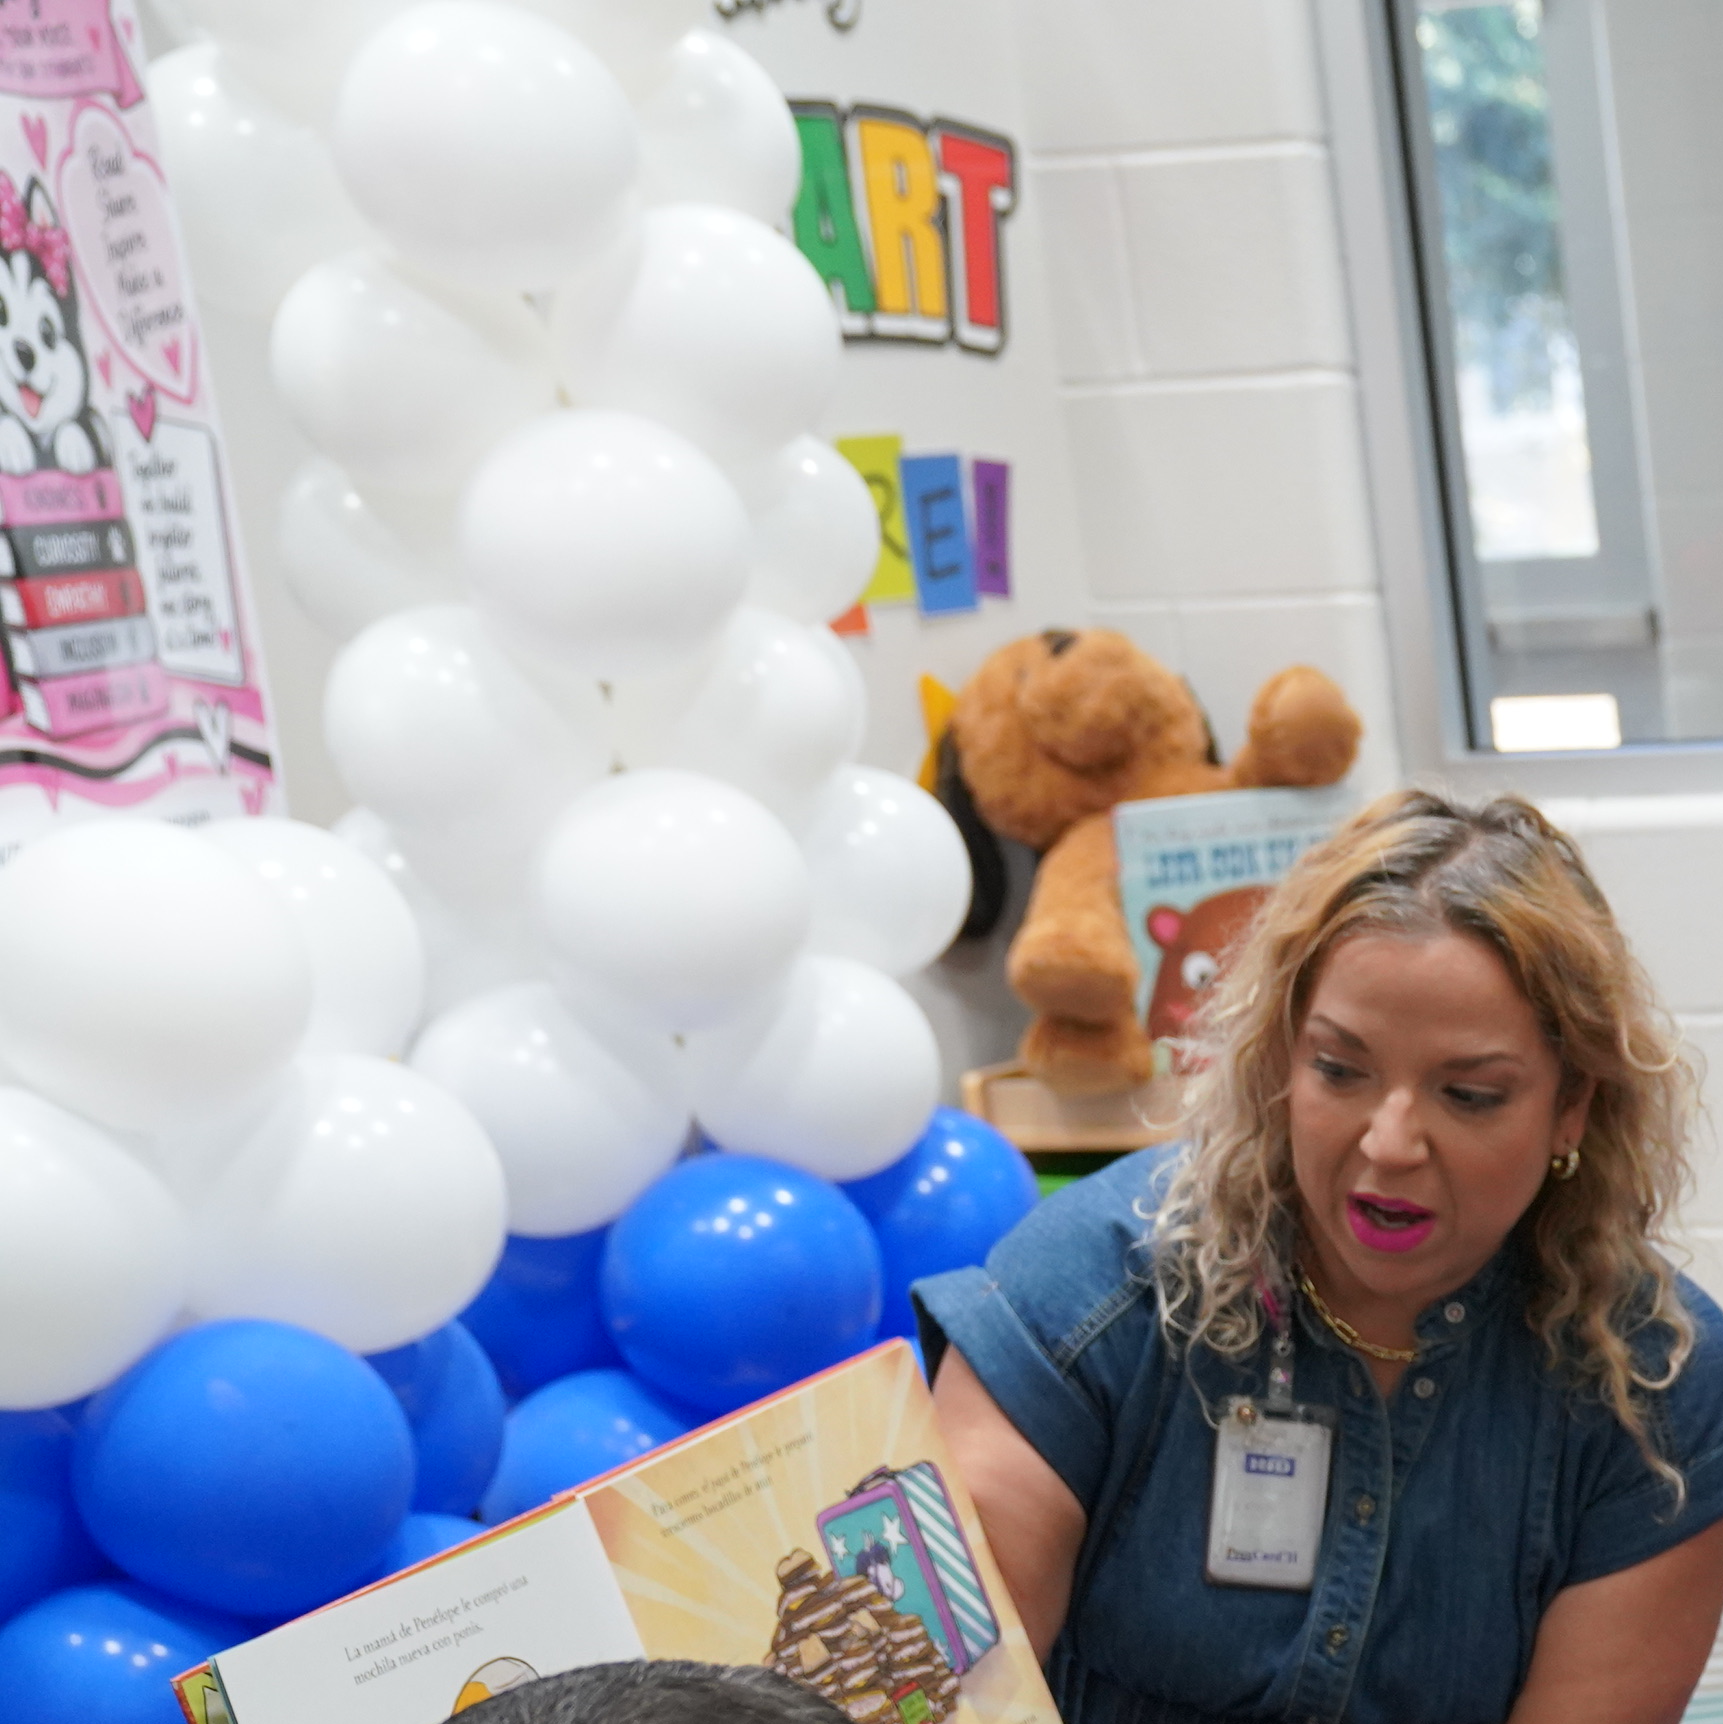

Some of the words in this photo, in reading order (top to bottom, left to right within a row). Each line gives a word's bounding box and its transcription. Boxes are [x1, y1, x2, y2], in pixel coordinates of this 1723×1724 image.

[788, 100, 1015, 352] ART
[344, 1646, 362, 1663] La
[363, 1629, 399, 1655] mamá
[399, 1622, 413, 1640] de
[412, 1605, 461, 1634] Penélope
[460, 1596, 472, 1613] le
[508, 1575, 530, 1593] una
[353, 1657, 397, 1686] mochila
[398, 1643, 431, 1667] nueva
[431, 1634, 452, 1653] con
